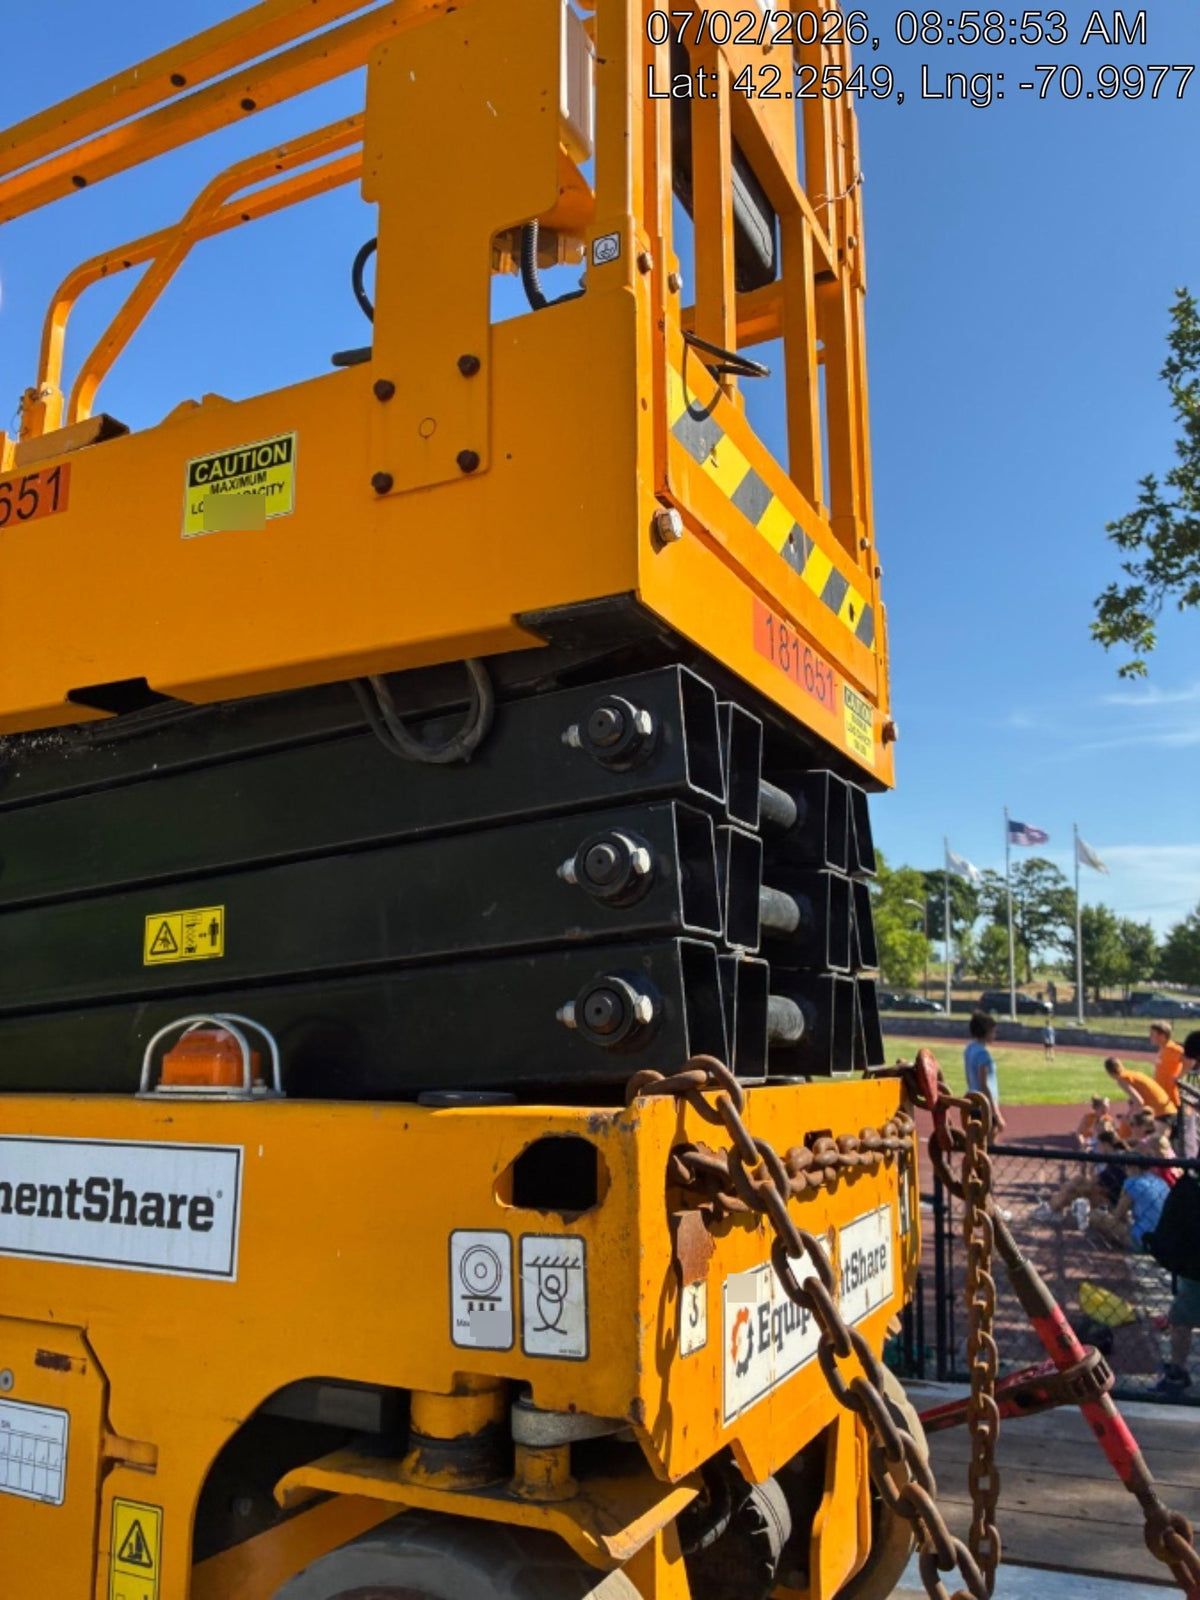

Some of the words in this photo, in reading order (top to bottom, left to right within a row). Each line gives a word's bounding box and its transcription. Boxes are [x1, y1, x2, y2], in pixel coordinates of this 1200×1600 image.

[195, 441, 288, 484] CAUTION
[210, 471, 267, 495] MAXIMUM
[765, 612, 834, 708] 181651
